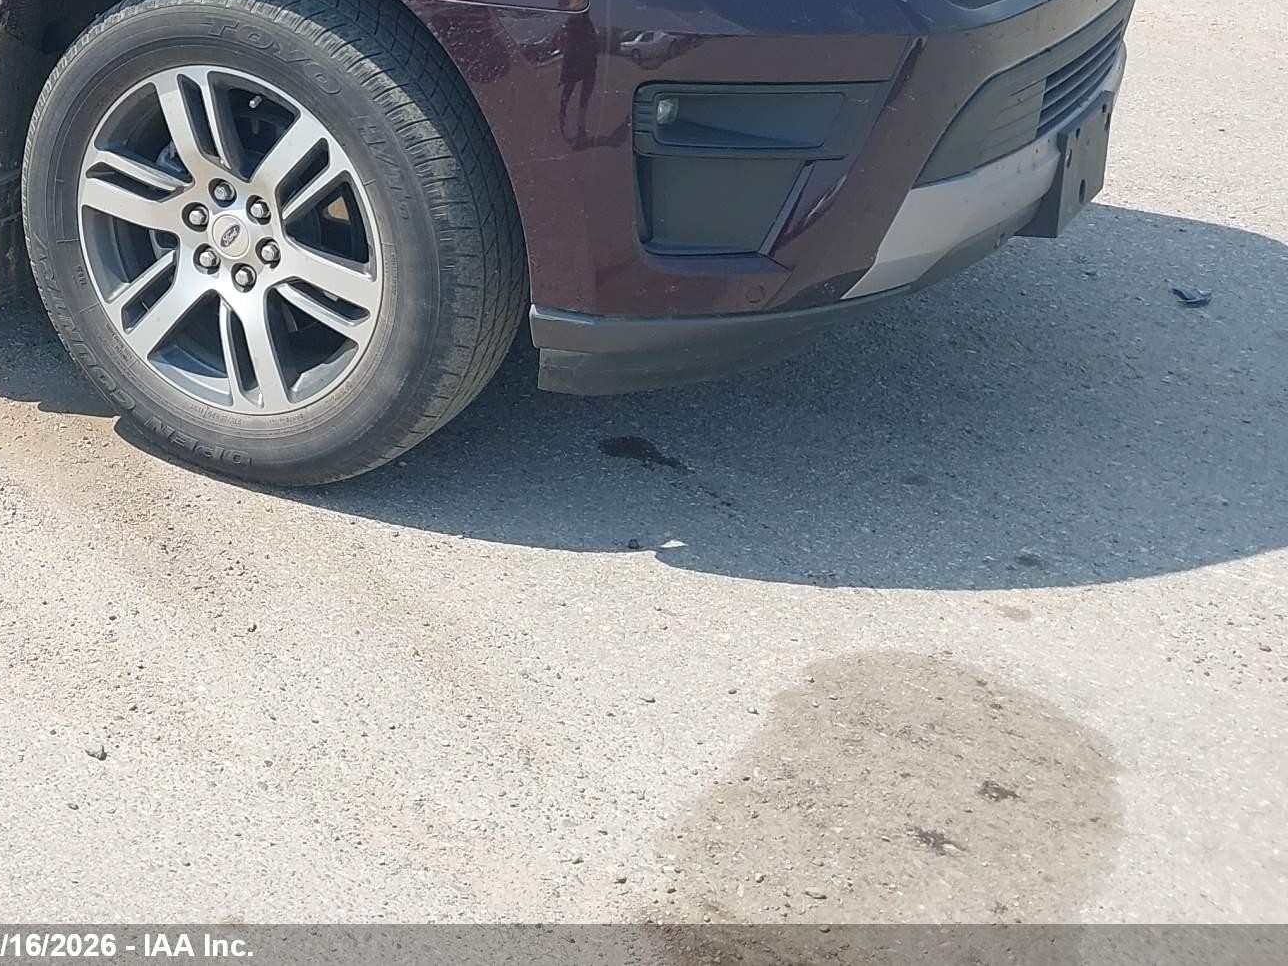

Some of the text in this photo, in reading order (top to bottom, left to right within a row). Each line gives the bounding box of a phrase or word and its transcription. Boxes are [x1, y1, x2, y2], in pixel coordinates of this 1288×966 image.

[203, 17, 343, 95] TOYO
[221, 226, 240, 246] Ford
[33, 233, 136, 411] COUNTRY
[143, 416, 250, 465] OPEN
